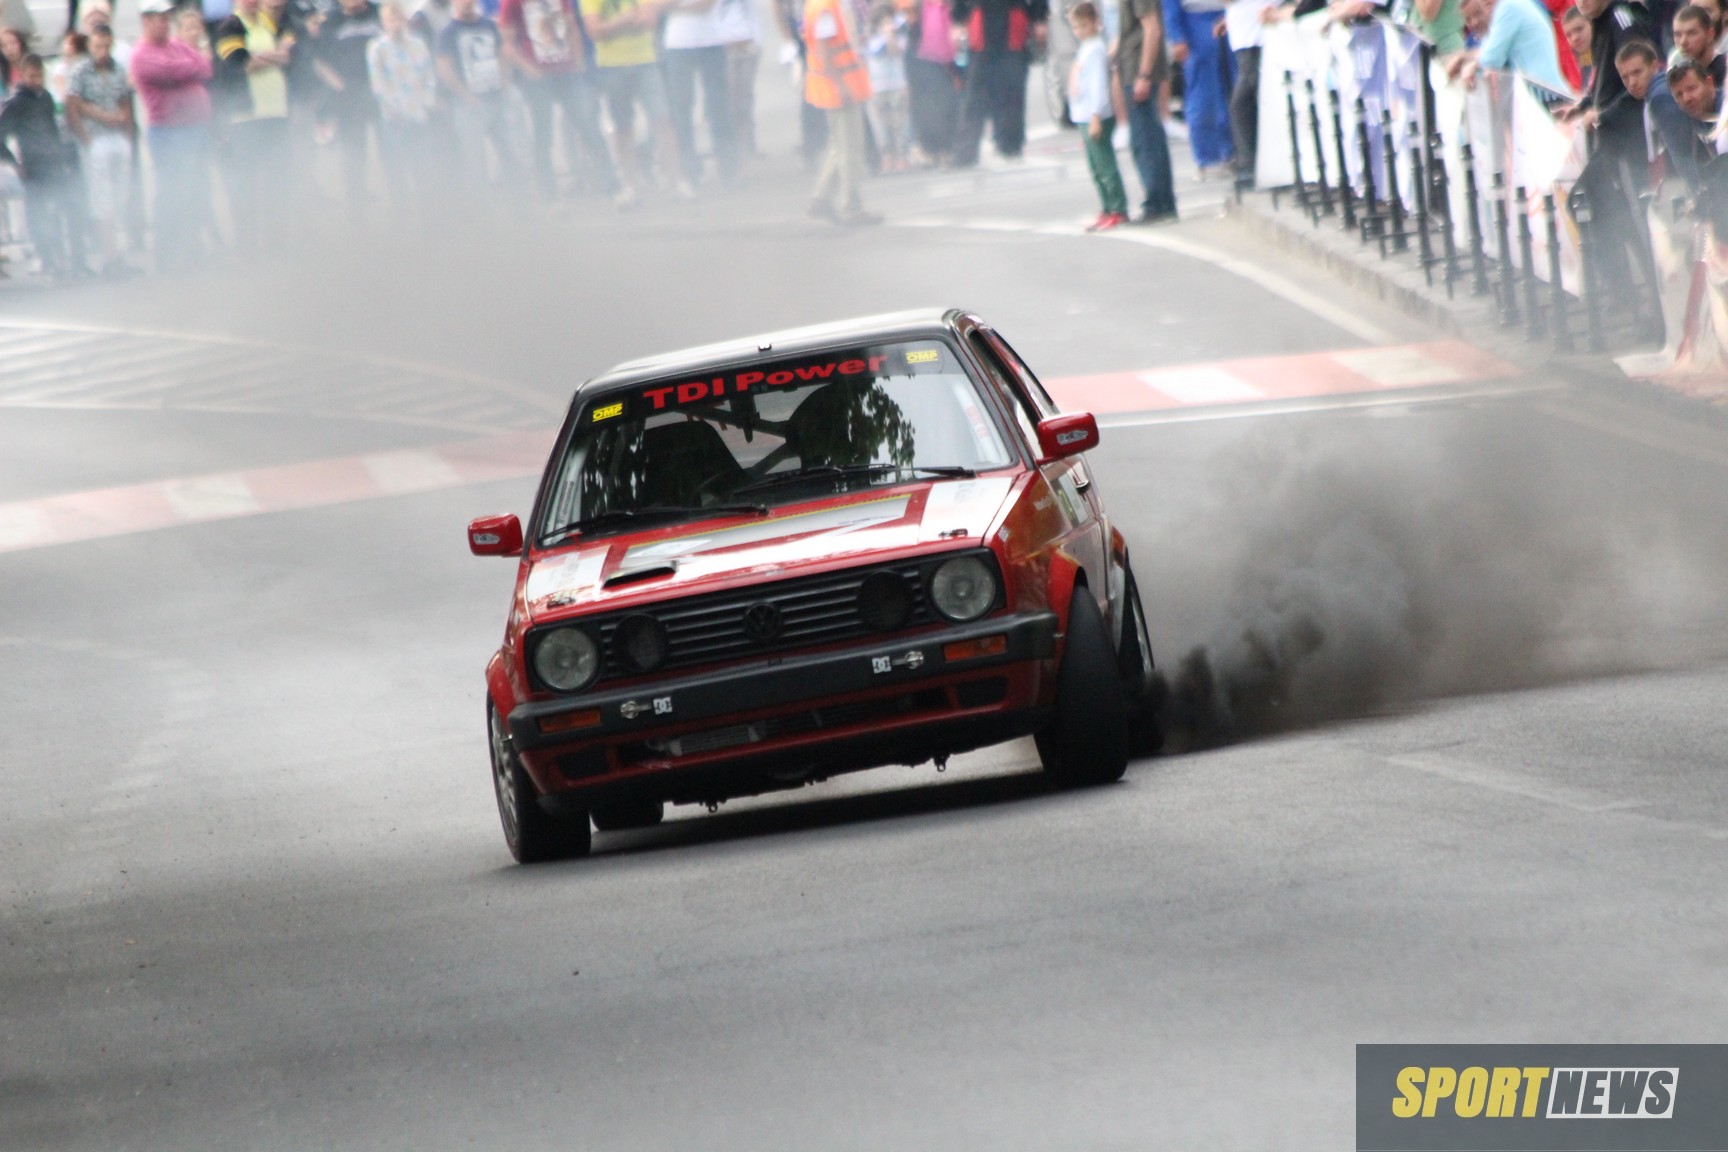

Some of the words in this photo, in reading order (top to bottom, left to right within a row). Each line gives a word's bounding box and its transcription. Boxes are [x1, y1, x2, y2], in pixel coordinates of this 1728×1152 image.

[906, 350, 938, 363] OMP
[644, 378, 725, 409] TDI
[738, 354, 887, 391] Power
[593, 403, 622, 421] OMP
